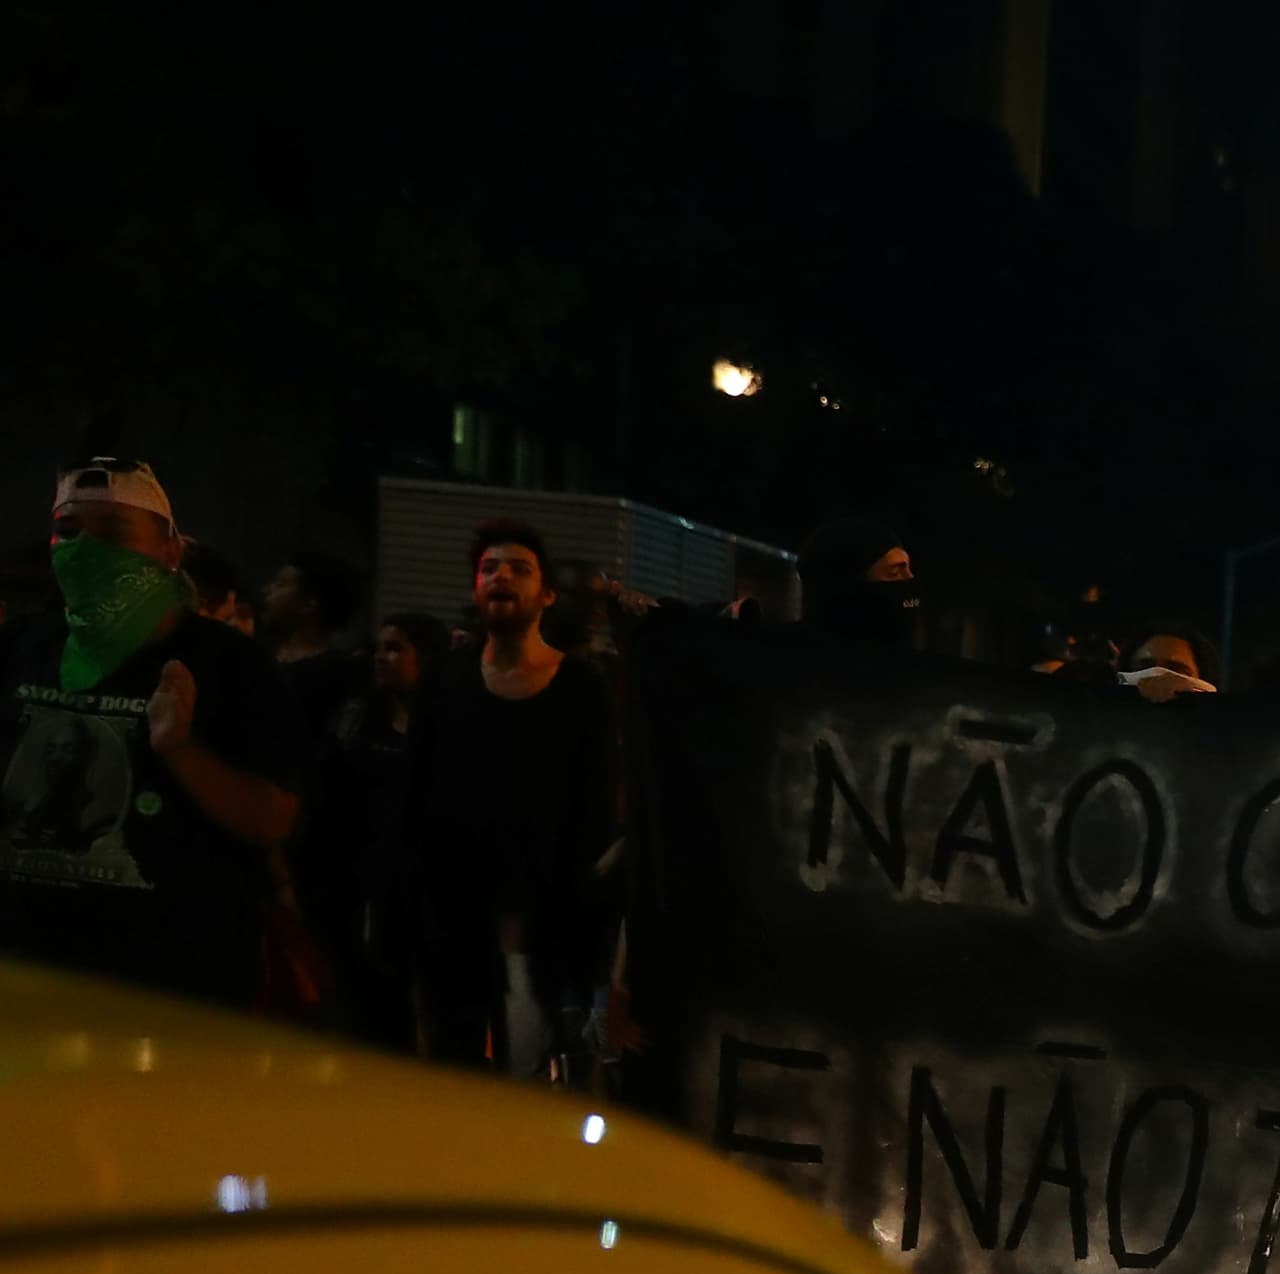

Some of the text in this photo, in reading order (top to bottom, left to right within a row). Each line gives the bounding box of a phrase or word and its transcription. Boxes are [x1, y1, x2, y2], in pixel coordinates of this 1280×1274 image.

[98, 696, 151, 713] DOG
[807, 716, 1166, 930] NÃO
[901, 1041, 1209, 1270] NÃO
